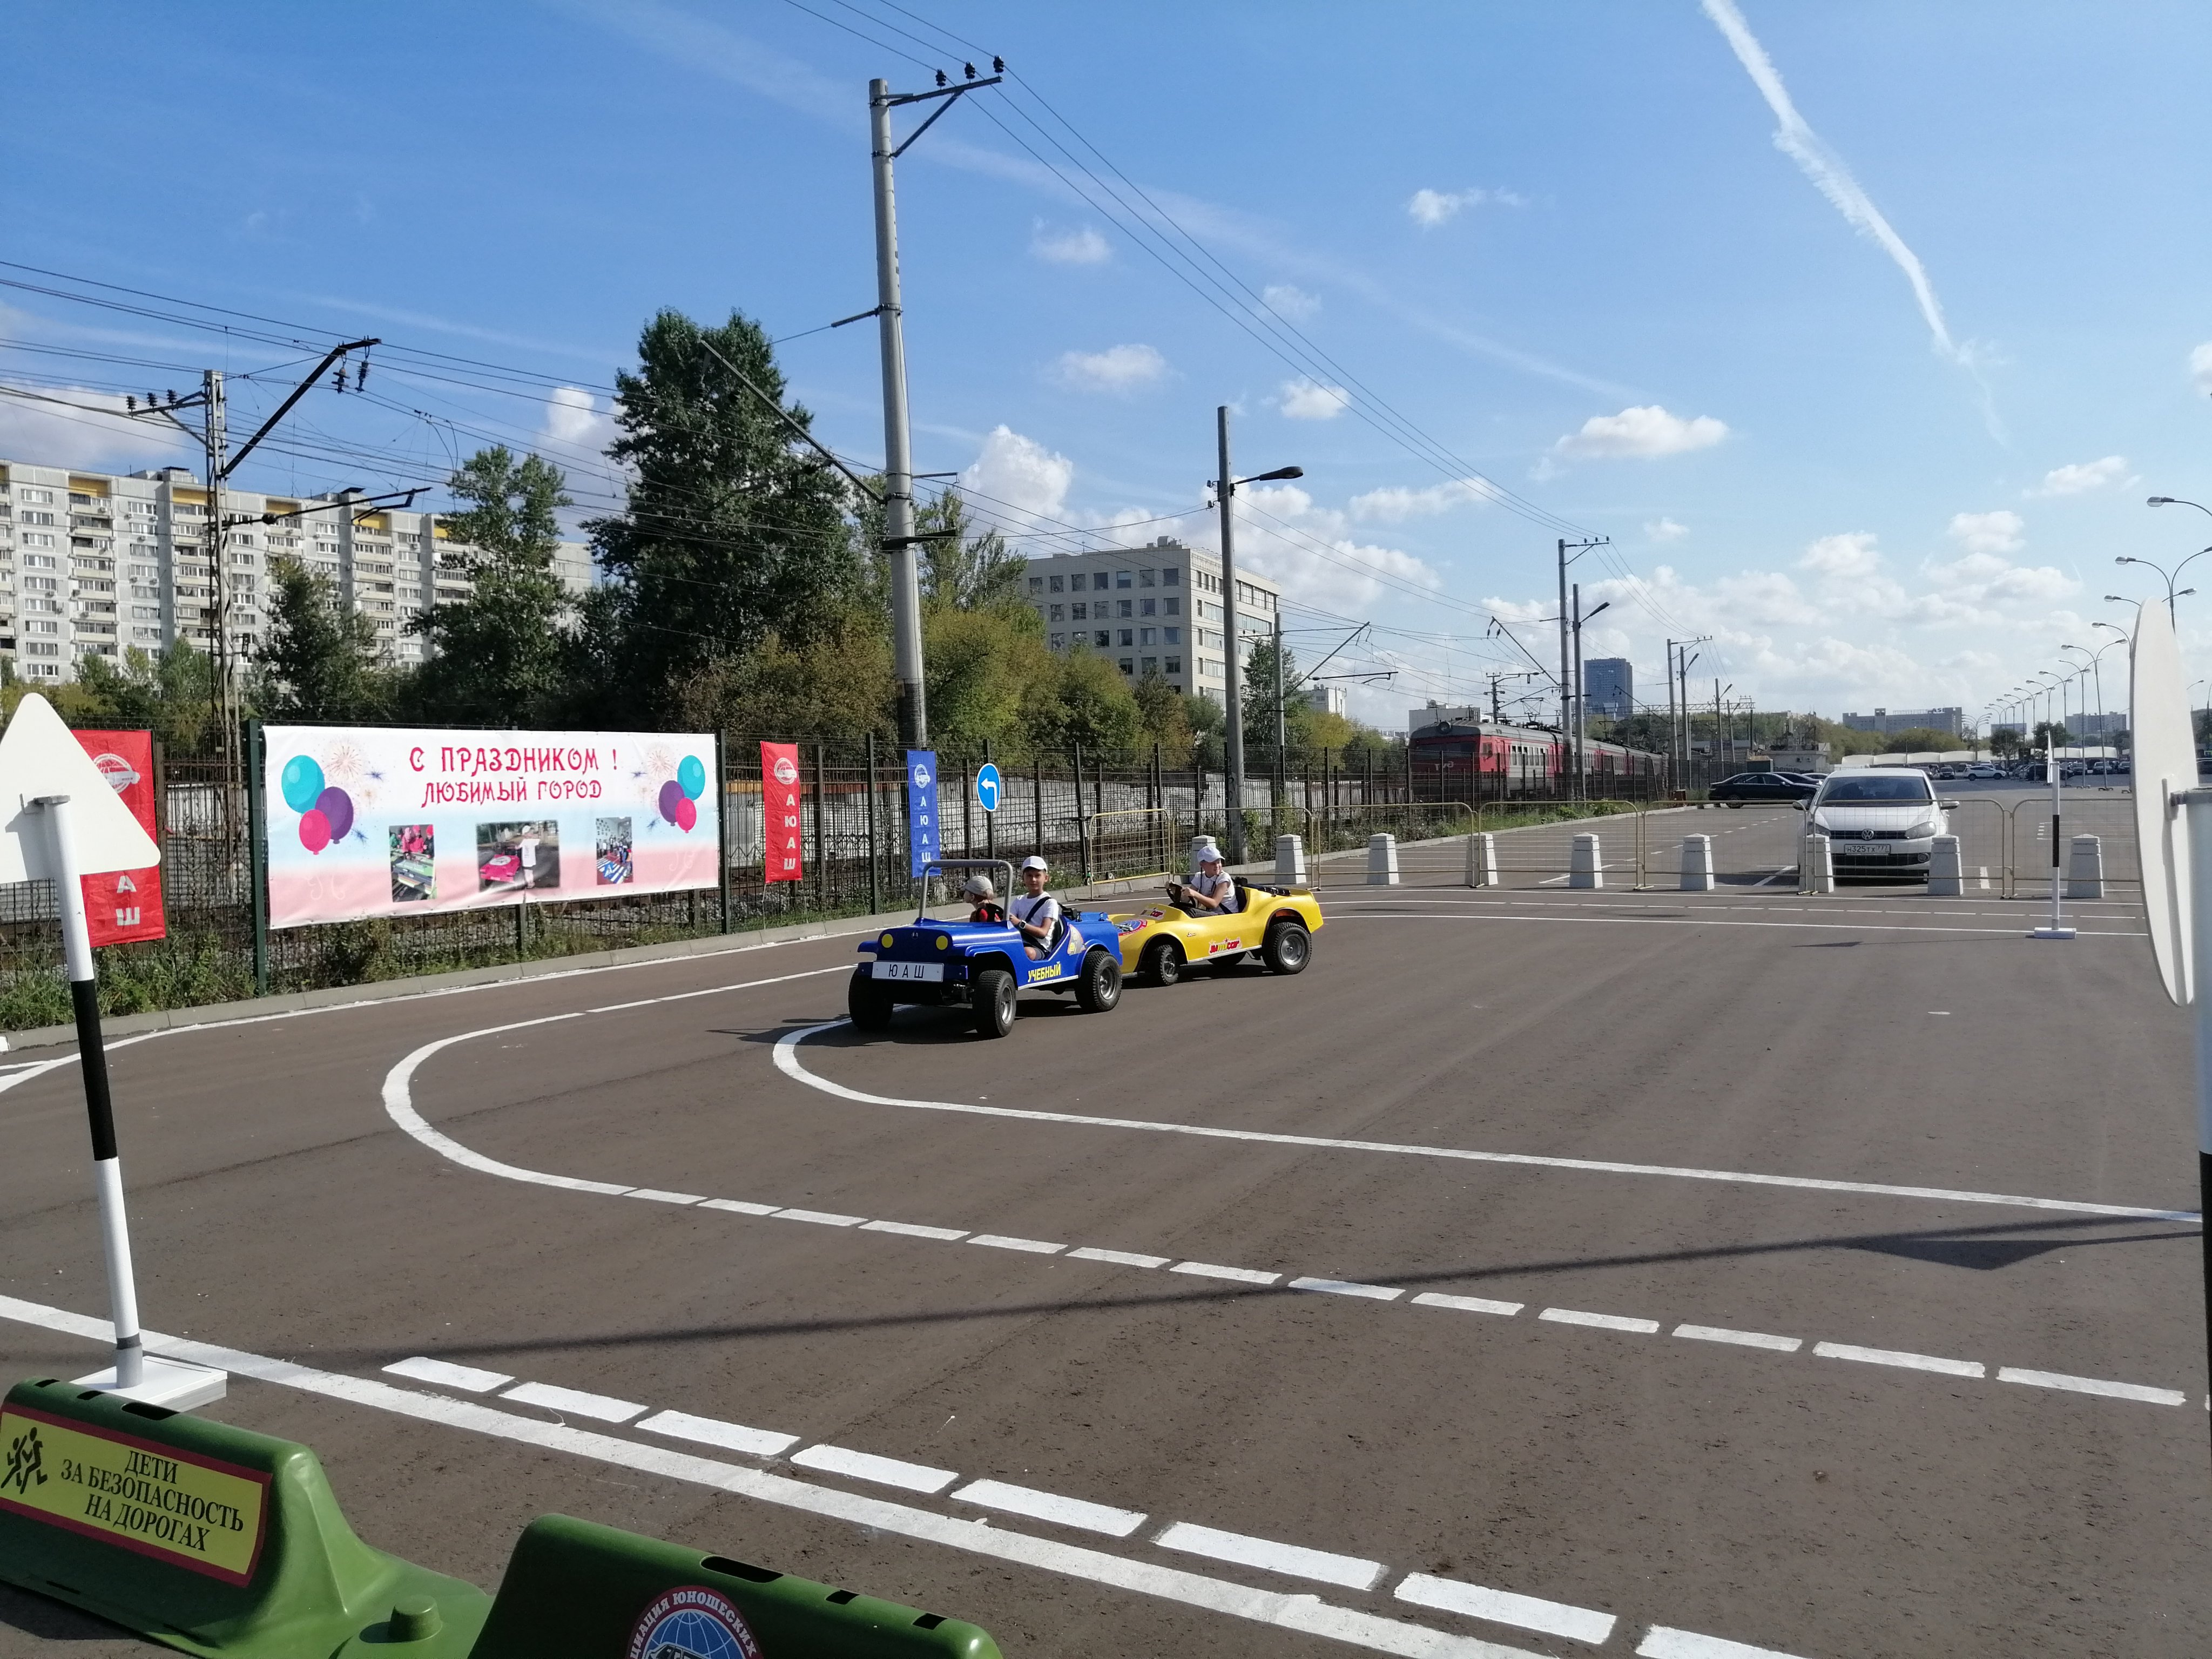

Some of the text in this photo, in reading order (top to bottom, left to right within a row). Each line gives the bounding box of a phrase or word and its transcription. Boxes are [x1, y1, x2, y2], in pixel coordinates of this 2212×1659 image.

[409, 747, 425, 772] С
[441, 747, 599, 777] ПРАЗДНИКОМ
[421, 776, 602, 808] ЛЮБИМЫЙ ГОРОД
[1028, 961, 1061, 982] УЧЕБНЫЙ
[125, 1450, 179, 1484] ДЕТИ
[61, 1459, 244, 1532] ЗА БЕЗОПАСНОСТЬ
[84, 1493, 210, 1552] НА ДОРОГАХ
[630, 1590, 757, 1659] ЦИАЦИЯ ЮНОШЕСКИХ
